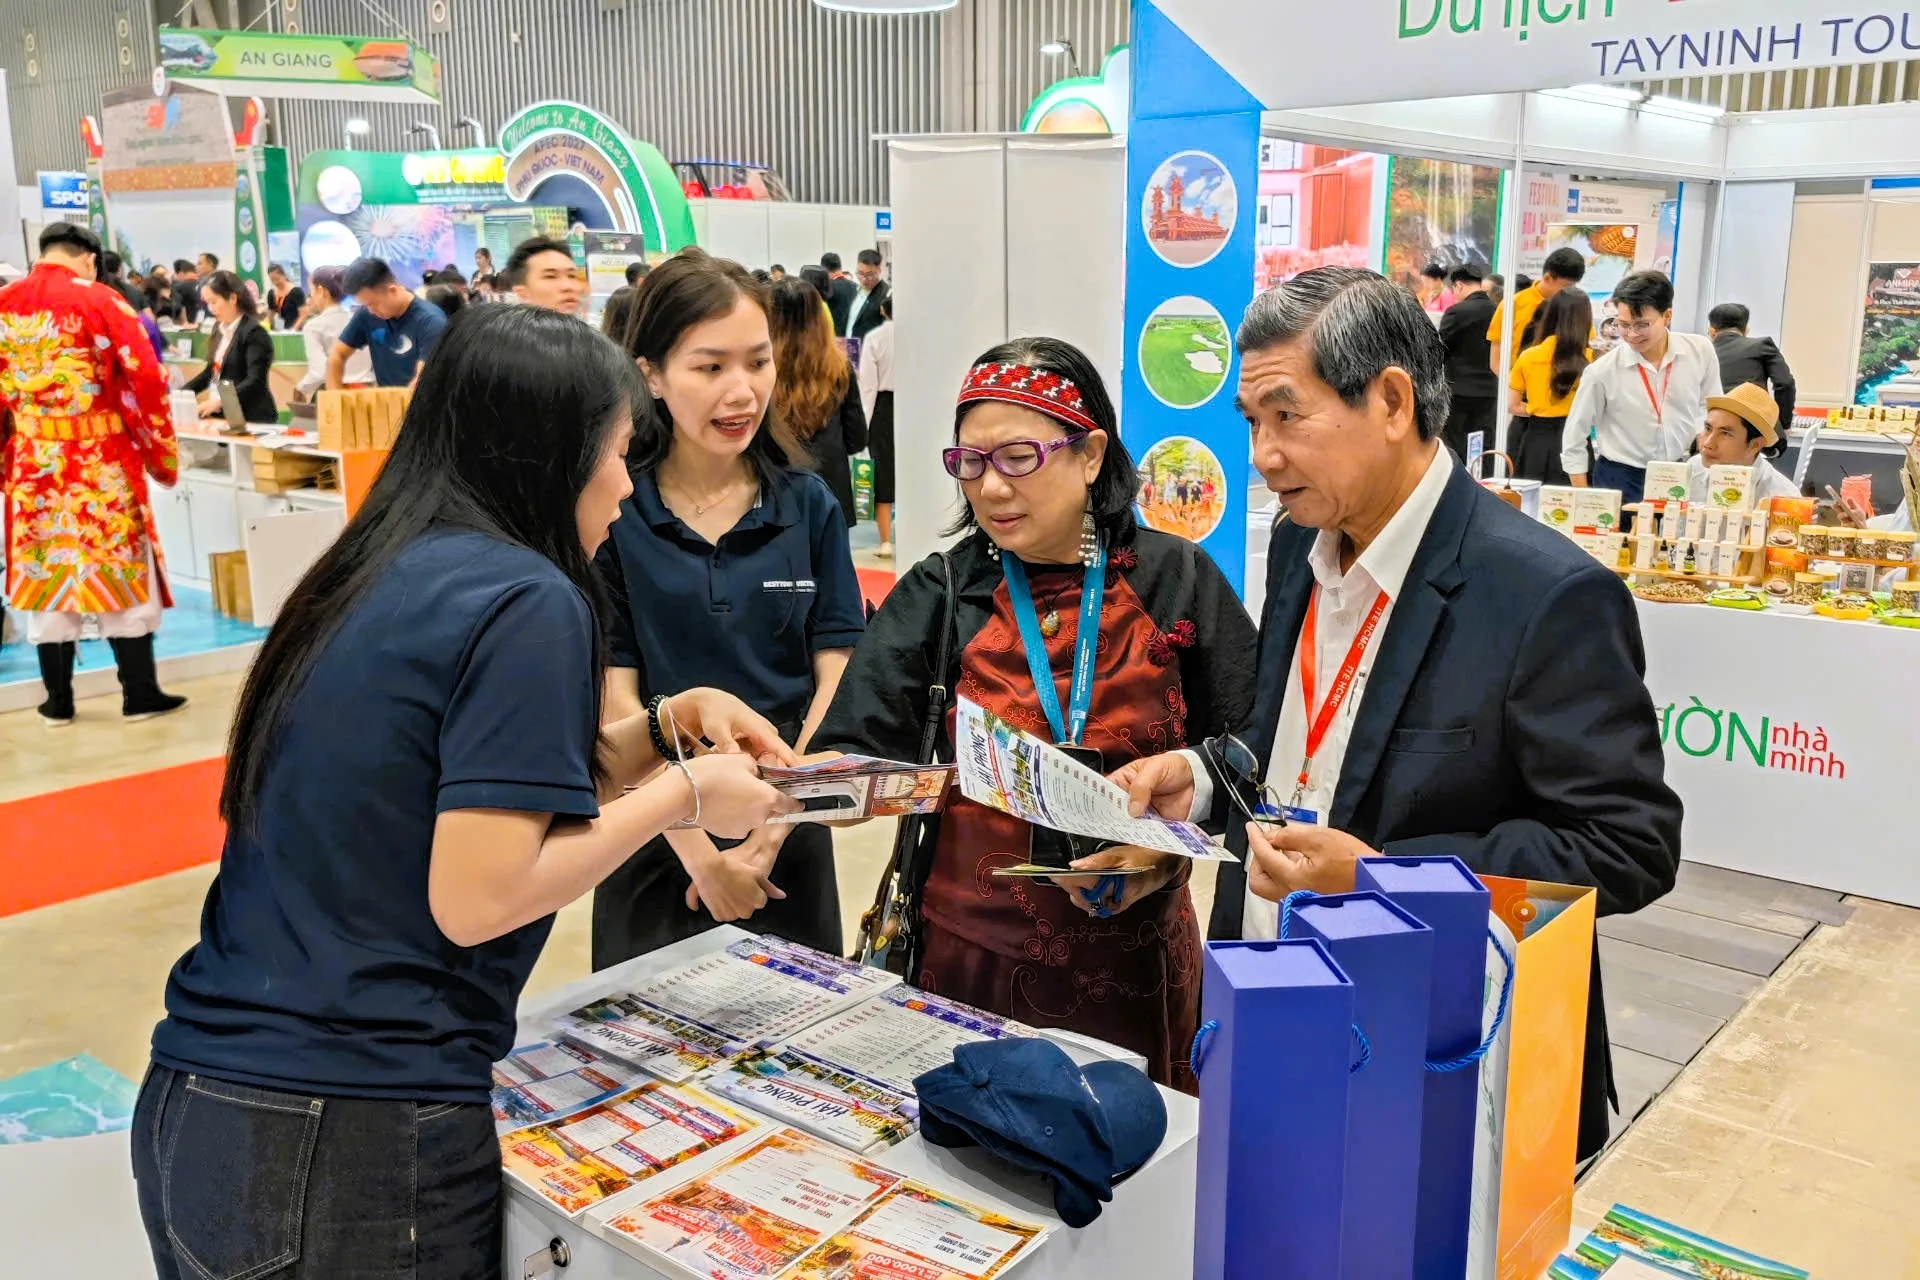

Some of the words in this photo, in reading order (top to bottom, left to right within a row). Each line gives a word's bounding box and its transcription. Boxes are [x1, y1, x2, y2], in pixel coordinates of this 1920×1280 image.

[239, 51, 267, 65] AN
[272, 52, 333, 69] GIANG
[1591, 23, 1802, 77] TAYNINH
[551, 109, 564, 127] to
[567, 108, 587, 130] An
[592, 121, 629, 170] Giang
[51, 190, 89, 206] SPO
[1371, 606, 1383, 623] ITE
[1357, 622, 1375, 651] HCMC
[1342, 665, 1355, 680] ITE
[1329, 680, 1347, 708] HCMC
[1772, 722, 1829, 753] nhà
[1770, 747, 1846, 780] mình
[866, 1253, 925, 1274] 1.000.000
